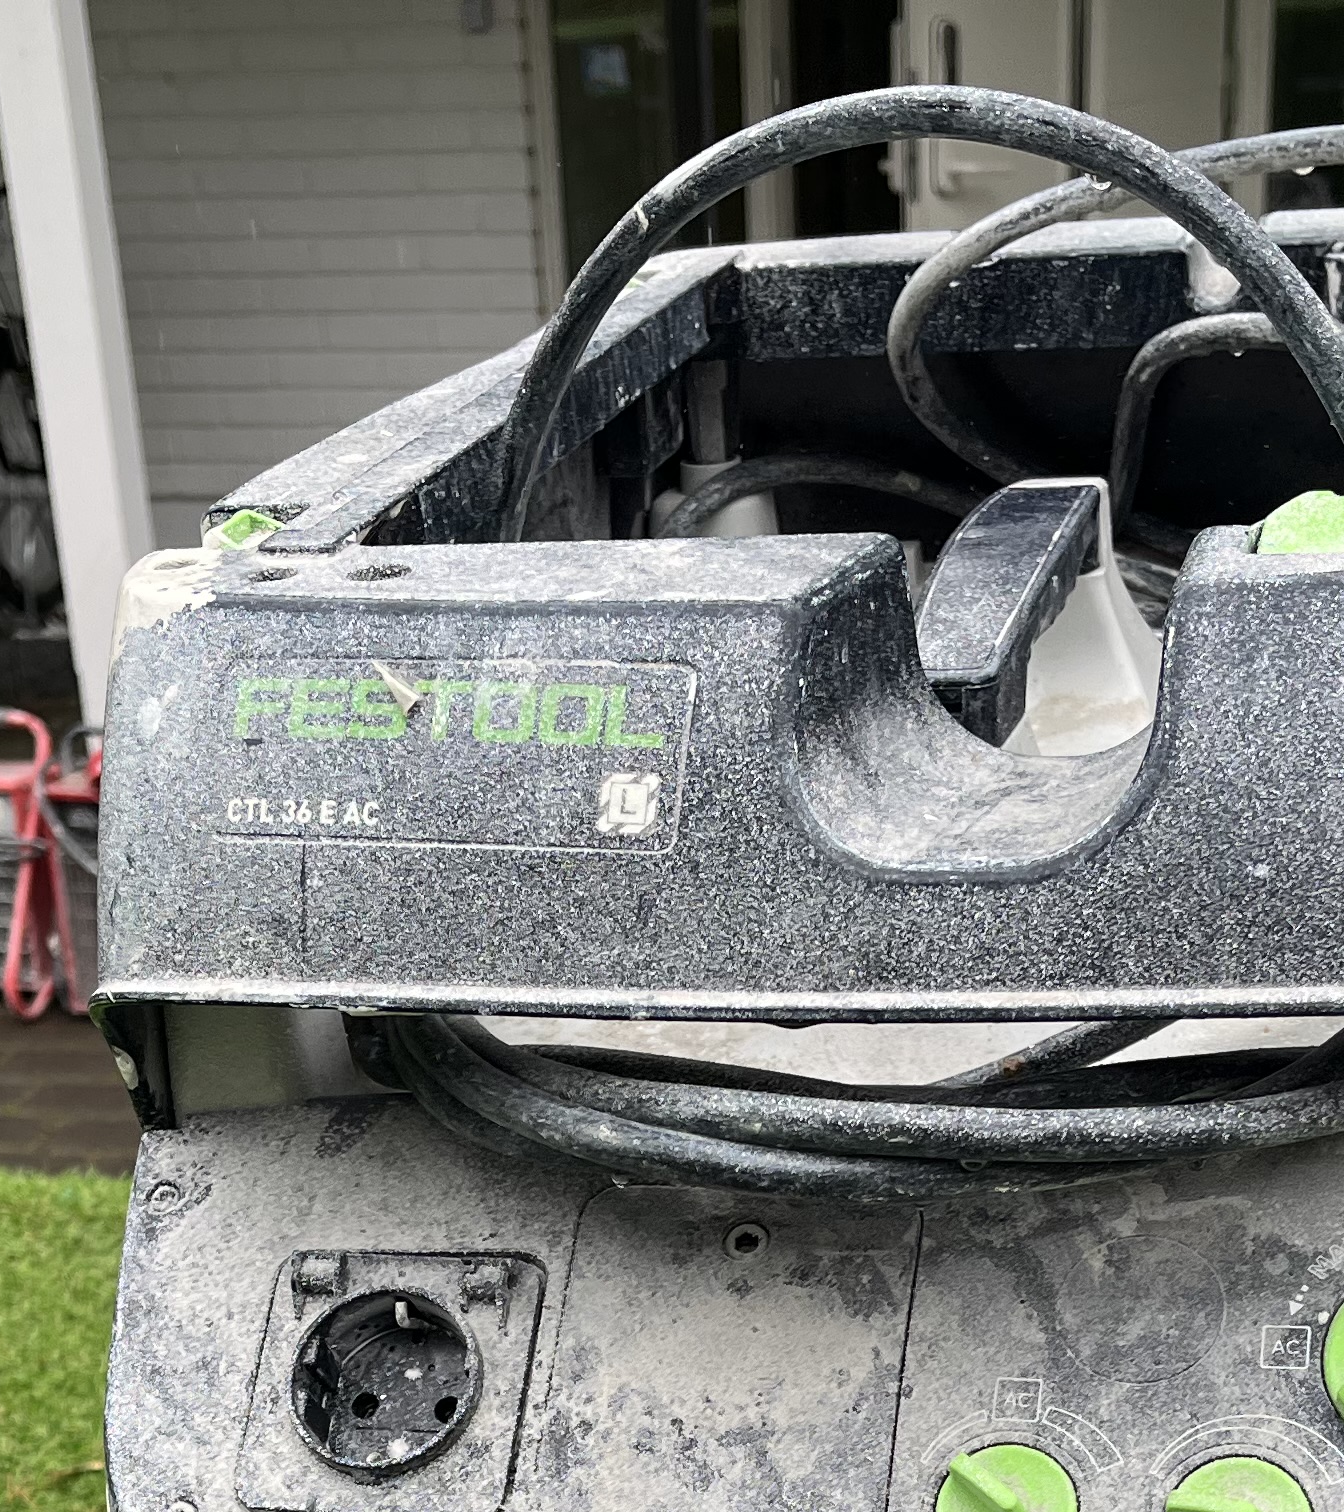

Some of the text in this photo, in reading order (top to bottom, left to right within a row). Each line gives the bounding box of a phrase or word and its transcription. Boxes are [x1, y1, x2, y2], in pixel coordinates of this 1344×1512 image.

[233, 678, 664, 749] FESTOOL
[227, 797, 381, 827] CTL 36 E AC
[1271, 1338, 1301, 1356] AC
[1004, 1391, 1033, 1408] AC
